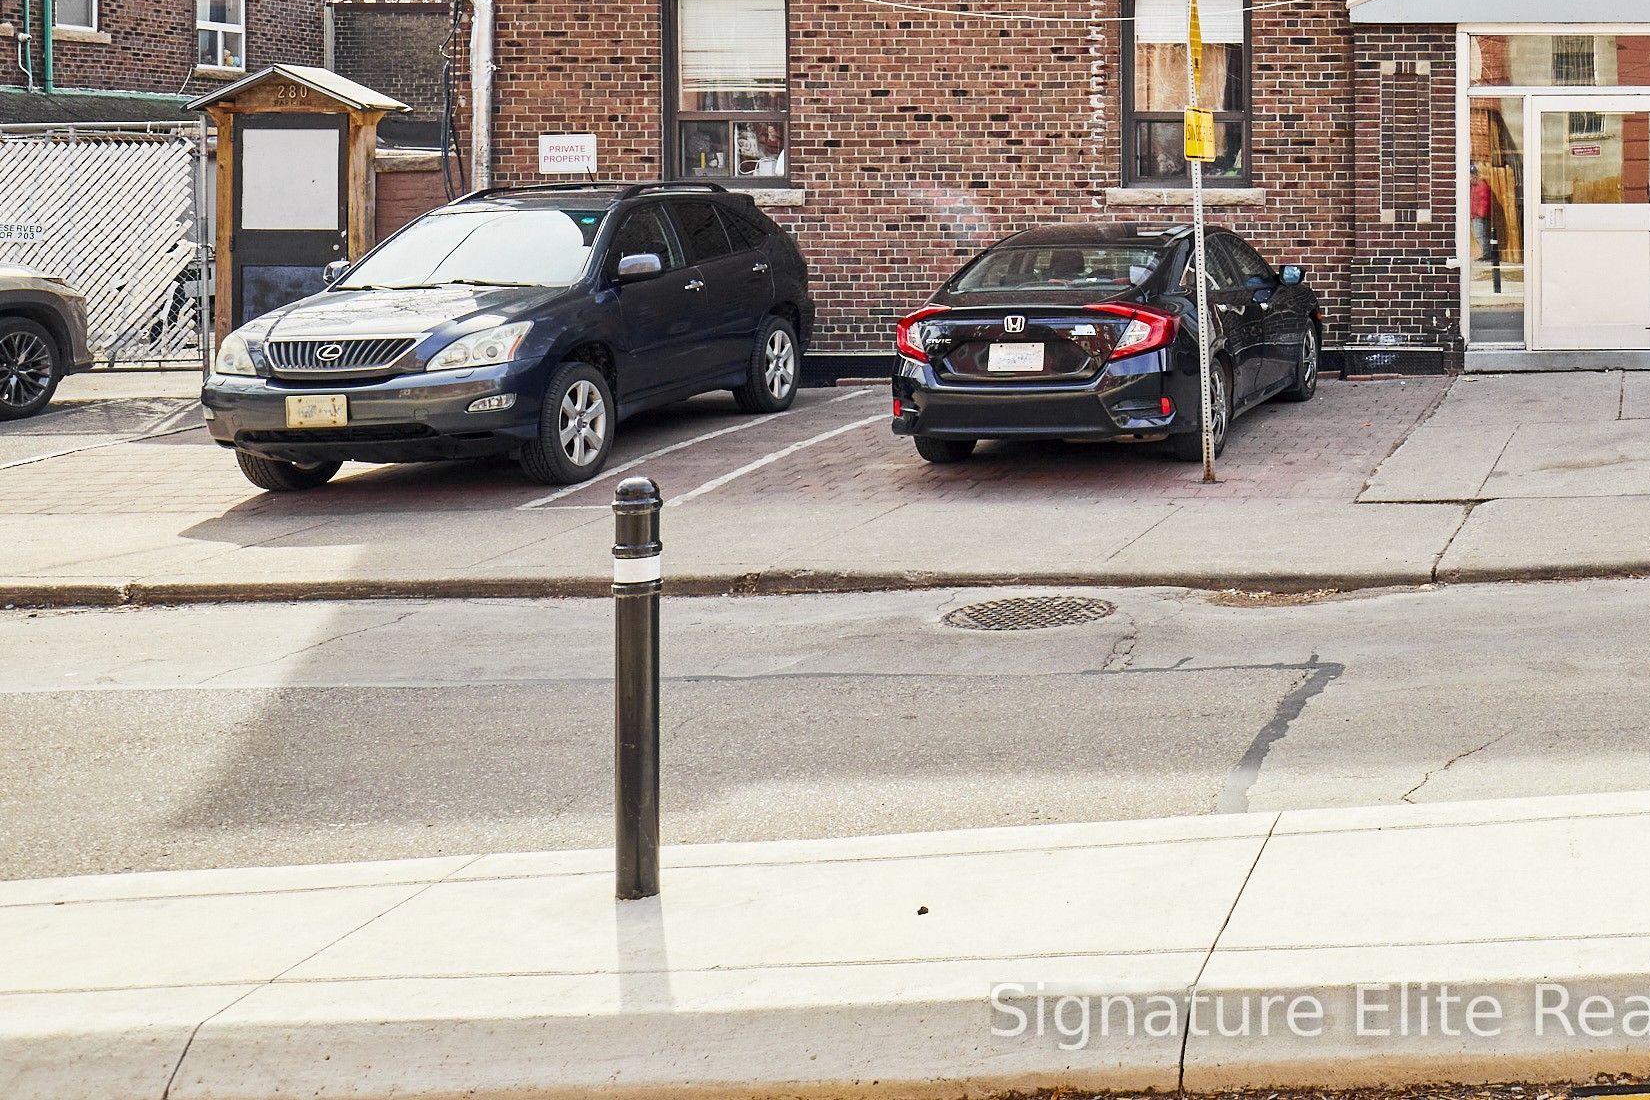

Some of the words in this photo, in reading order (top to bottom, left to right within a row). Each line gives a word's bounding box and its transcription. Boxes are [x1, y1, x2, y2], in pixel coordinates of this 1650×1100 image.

[278, 85, 308, 98] 280
[549, 145, 586, 153] PRIVATE
[543, 155, 592, 163] PROPERTY
[0, 224, 43, 233] ESERVED
[0, 231, 13, 239] OR
[17, 232, 35, 240] 203
